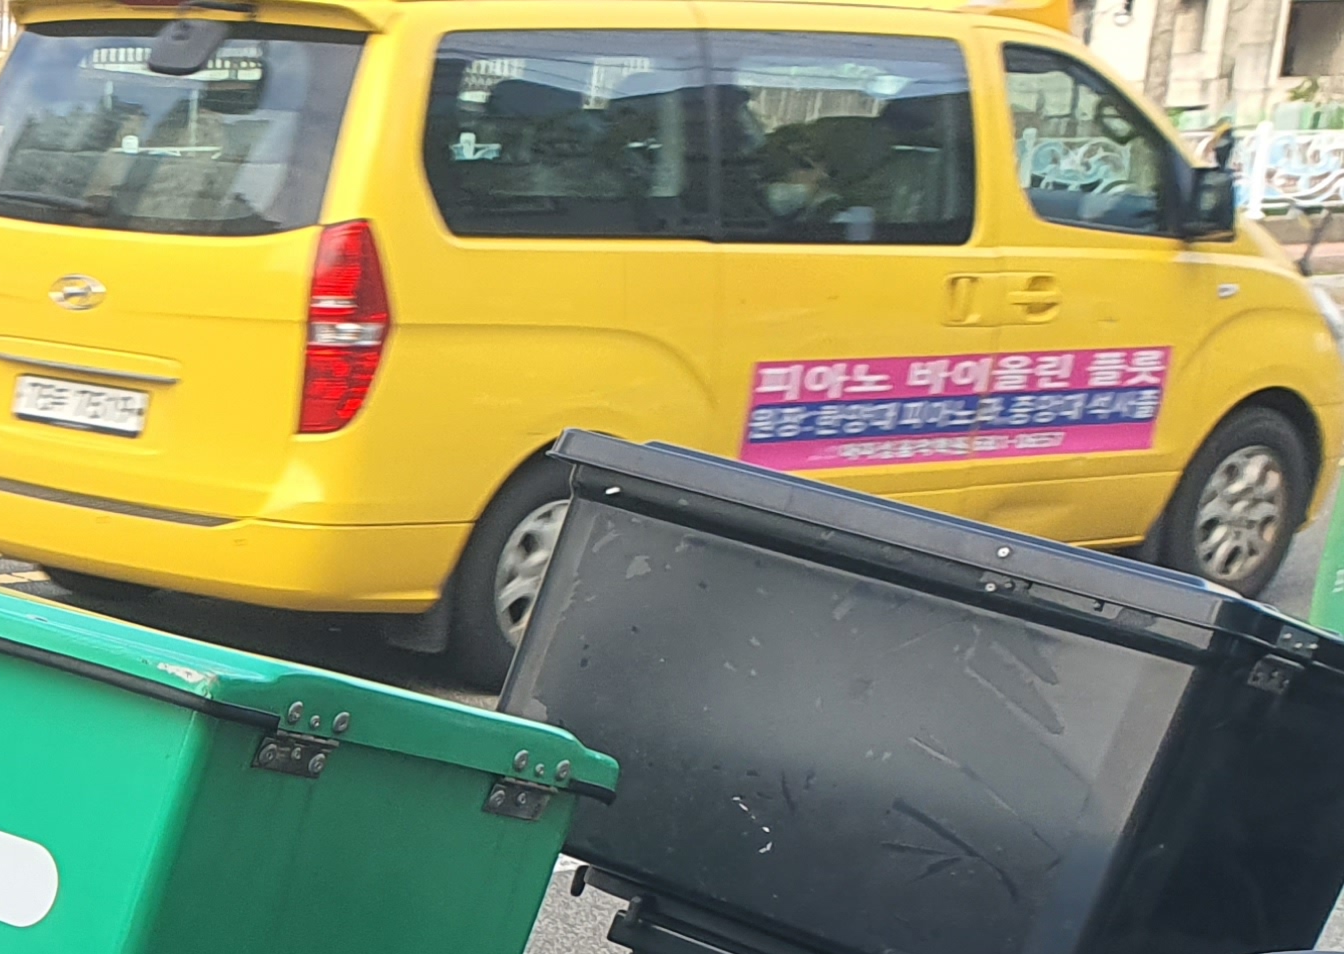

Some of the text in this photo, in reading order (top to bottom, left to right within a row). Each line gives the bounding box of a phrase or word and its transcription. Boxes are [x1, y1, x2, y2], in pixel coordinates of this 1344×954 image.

[755, 350, 1166, 400] 피아노 바이올린 플룻
